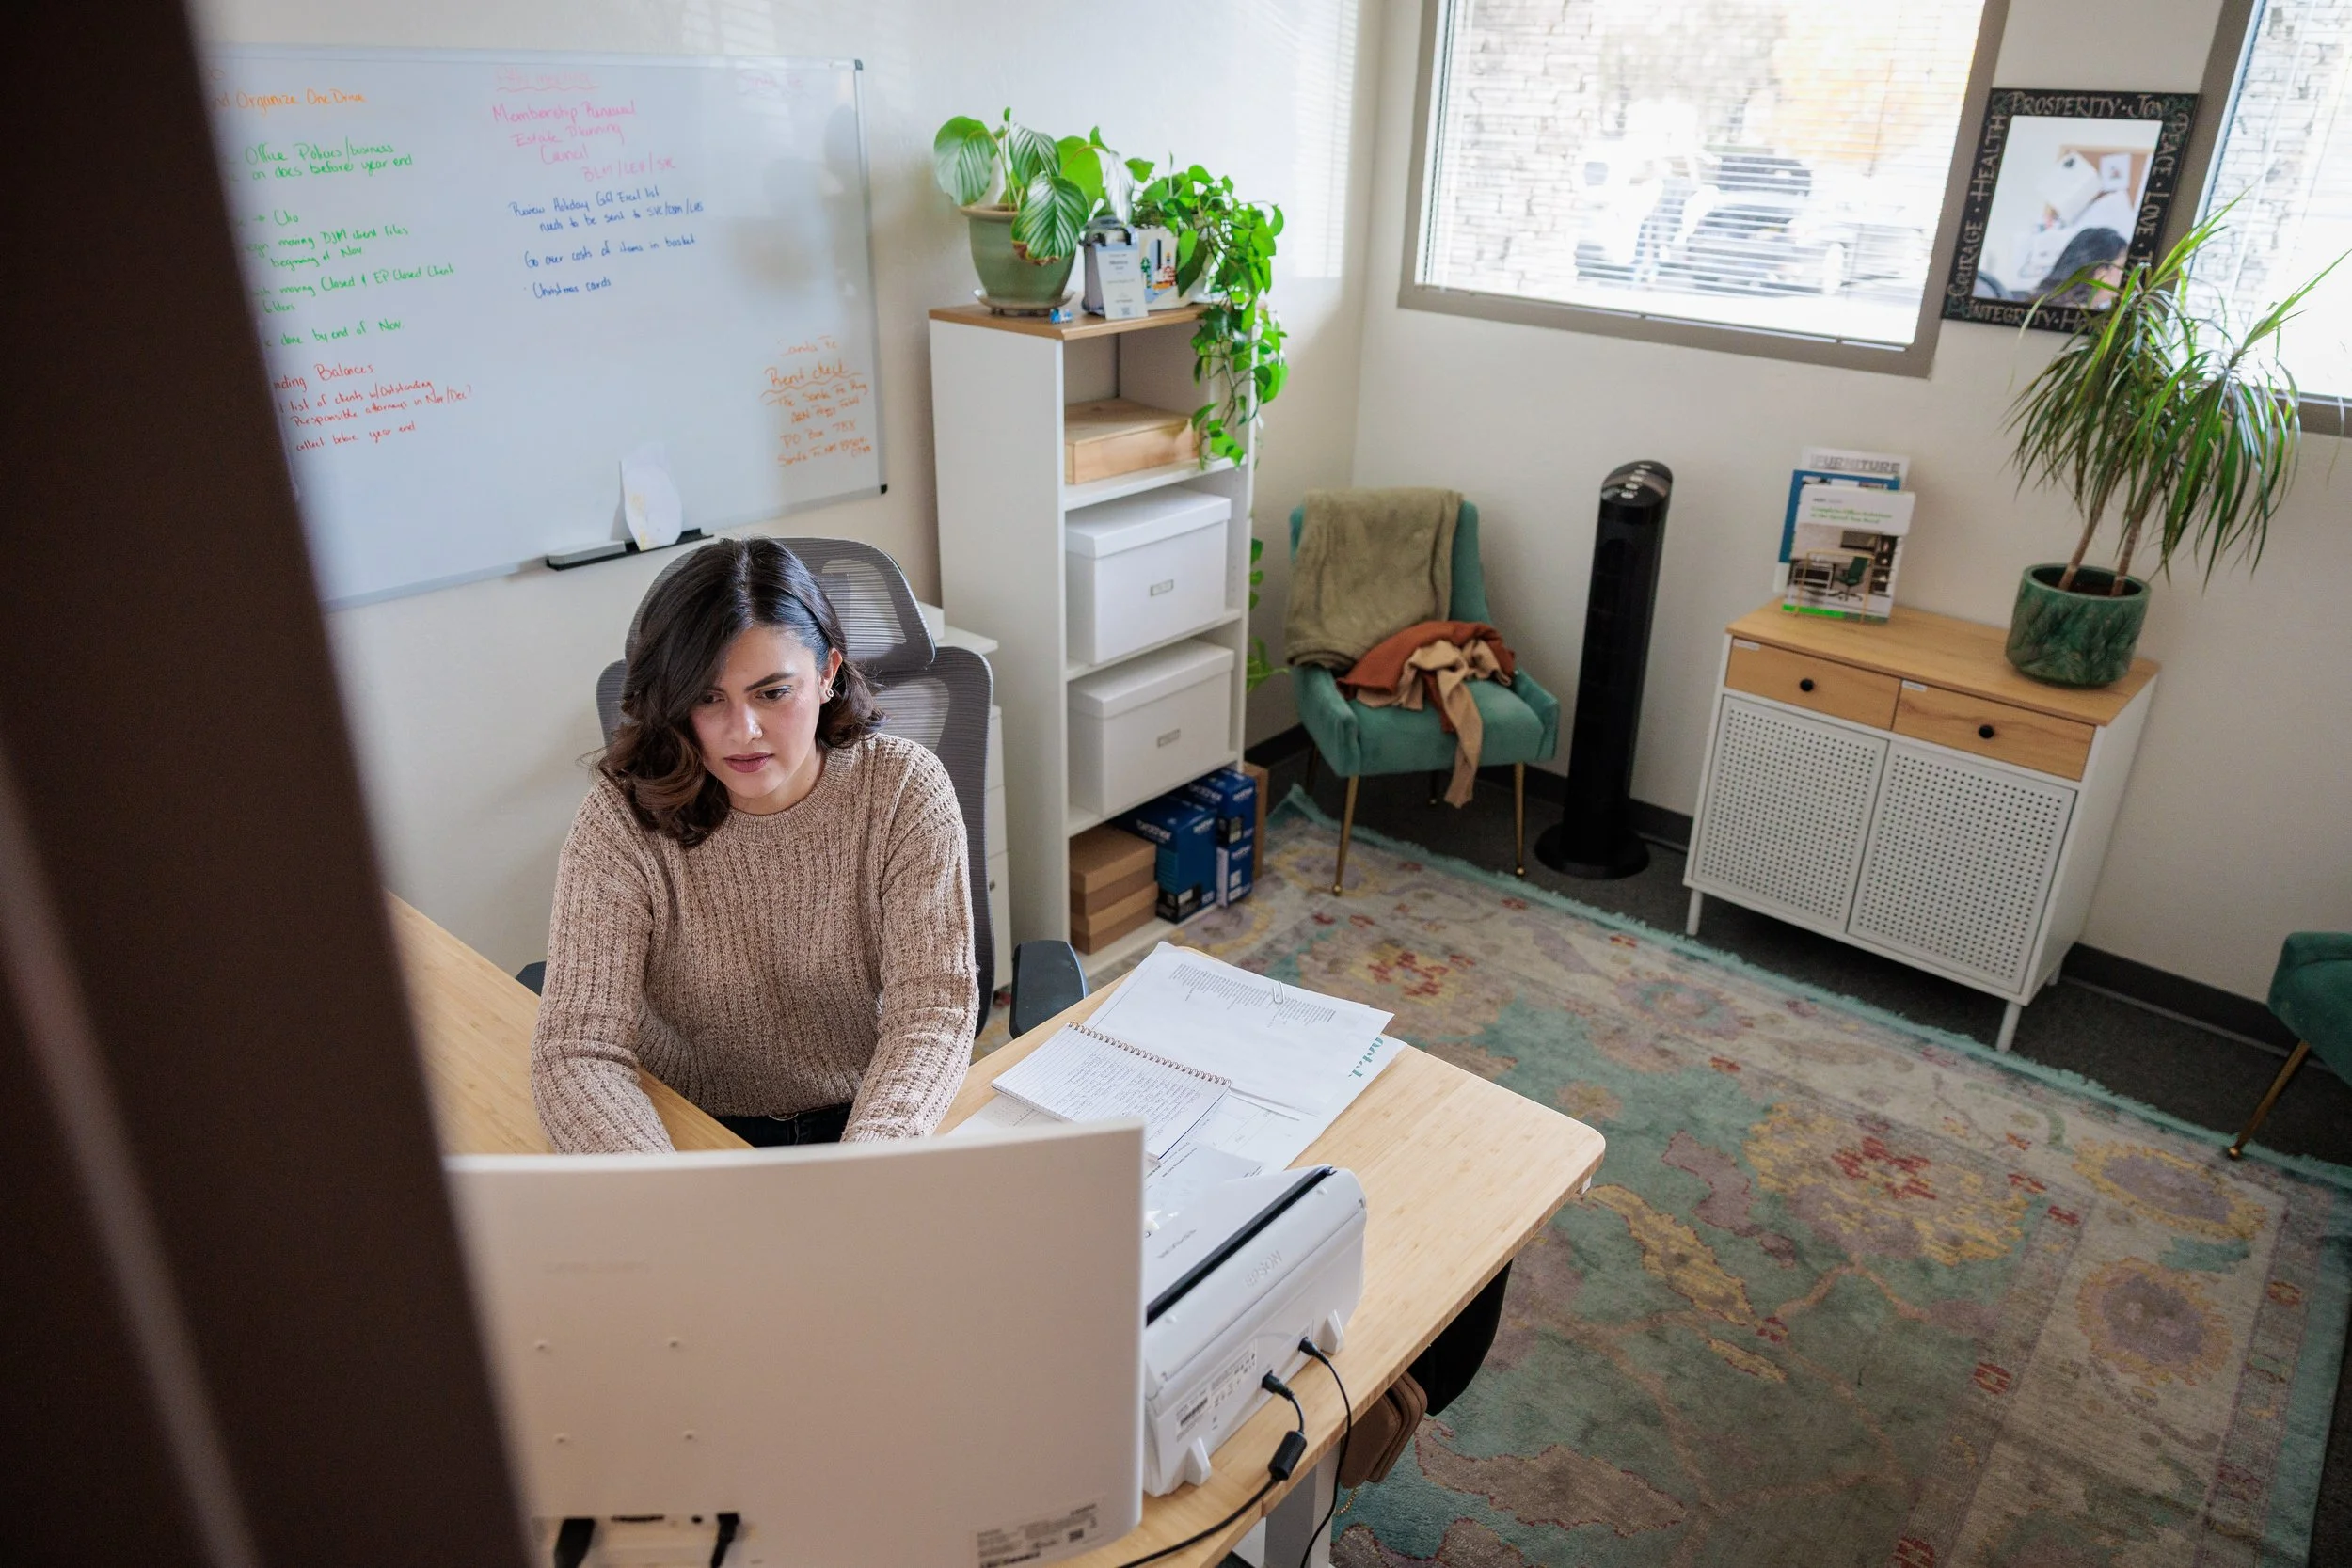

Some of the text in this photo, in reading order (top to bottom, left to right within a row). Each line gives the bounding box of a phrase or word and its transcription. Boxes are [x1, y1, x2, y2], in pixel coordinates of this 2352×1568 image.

[491, 102, 579, 124] Membership
[2010, 91, 2122, 119] PROSPERITY
[1970, 115, 2008, 201] HEALTH
[2152, 112, 2191, 177] PEACE
[360, 158, 389, 177] year
[392, 153, 414, 167] end
[2135, 191, 2170, 237] LOVE
[1966, 300, 2057, 327] INTEGRTY
[314, 363, 374, 382] Balances
